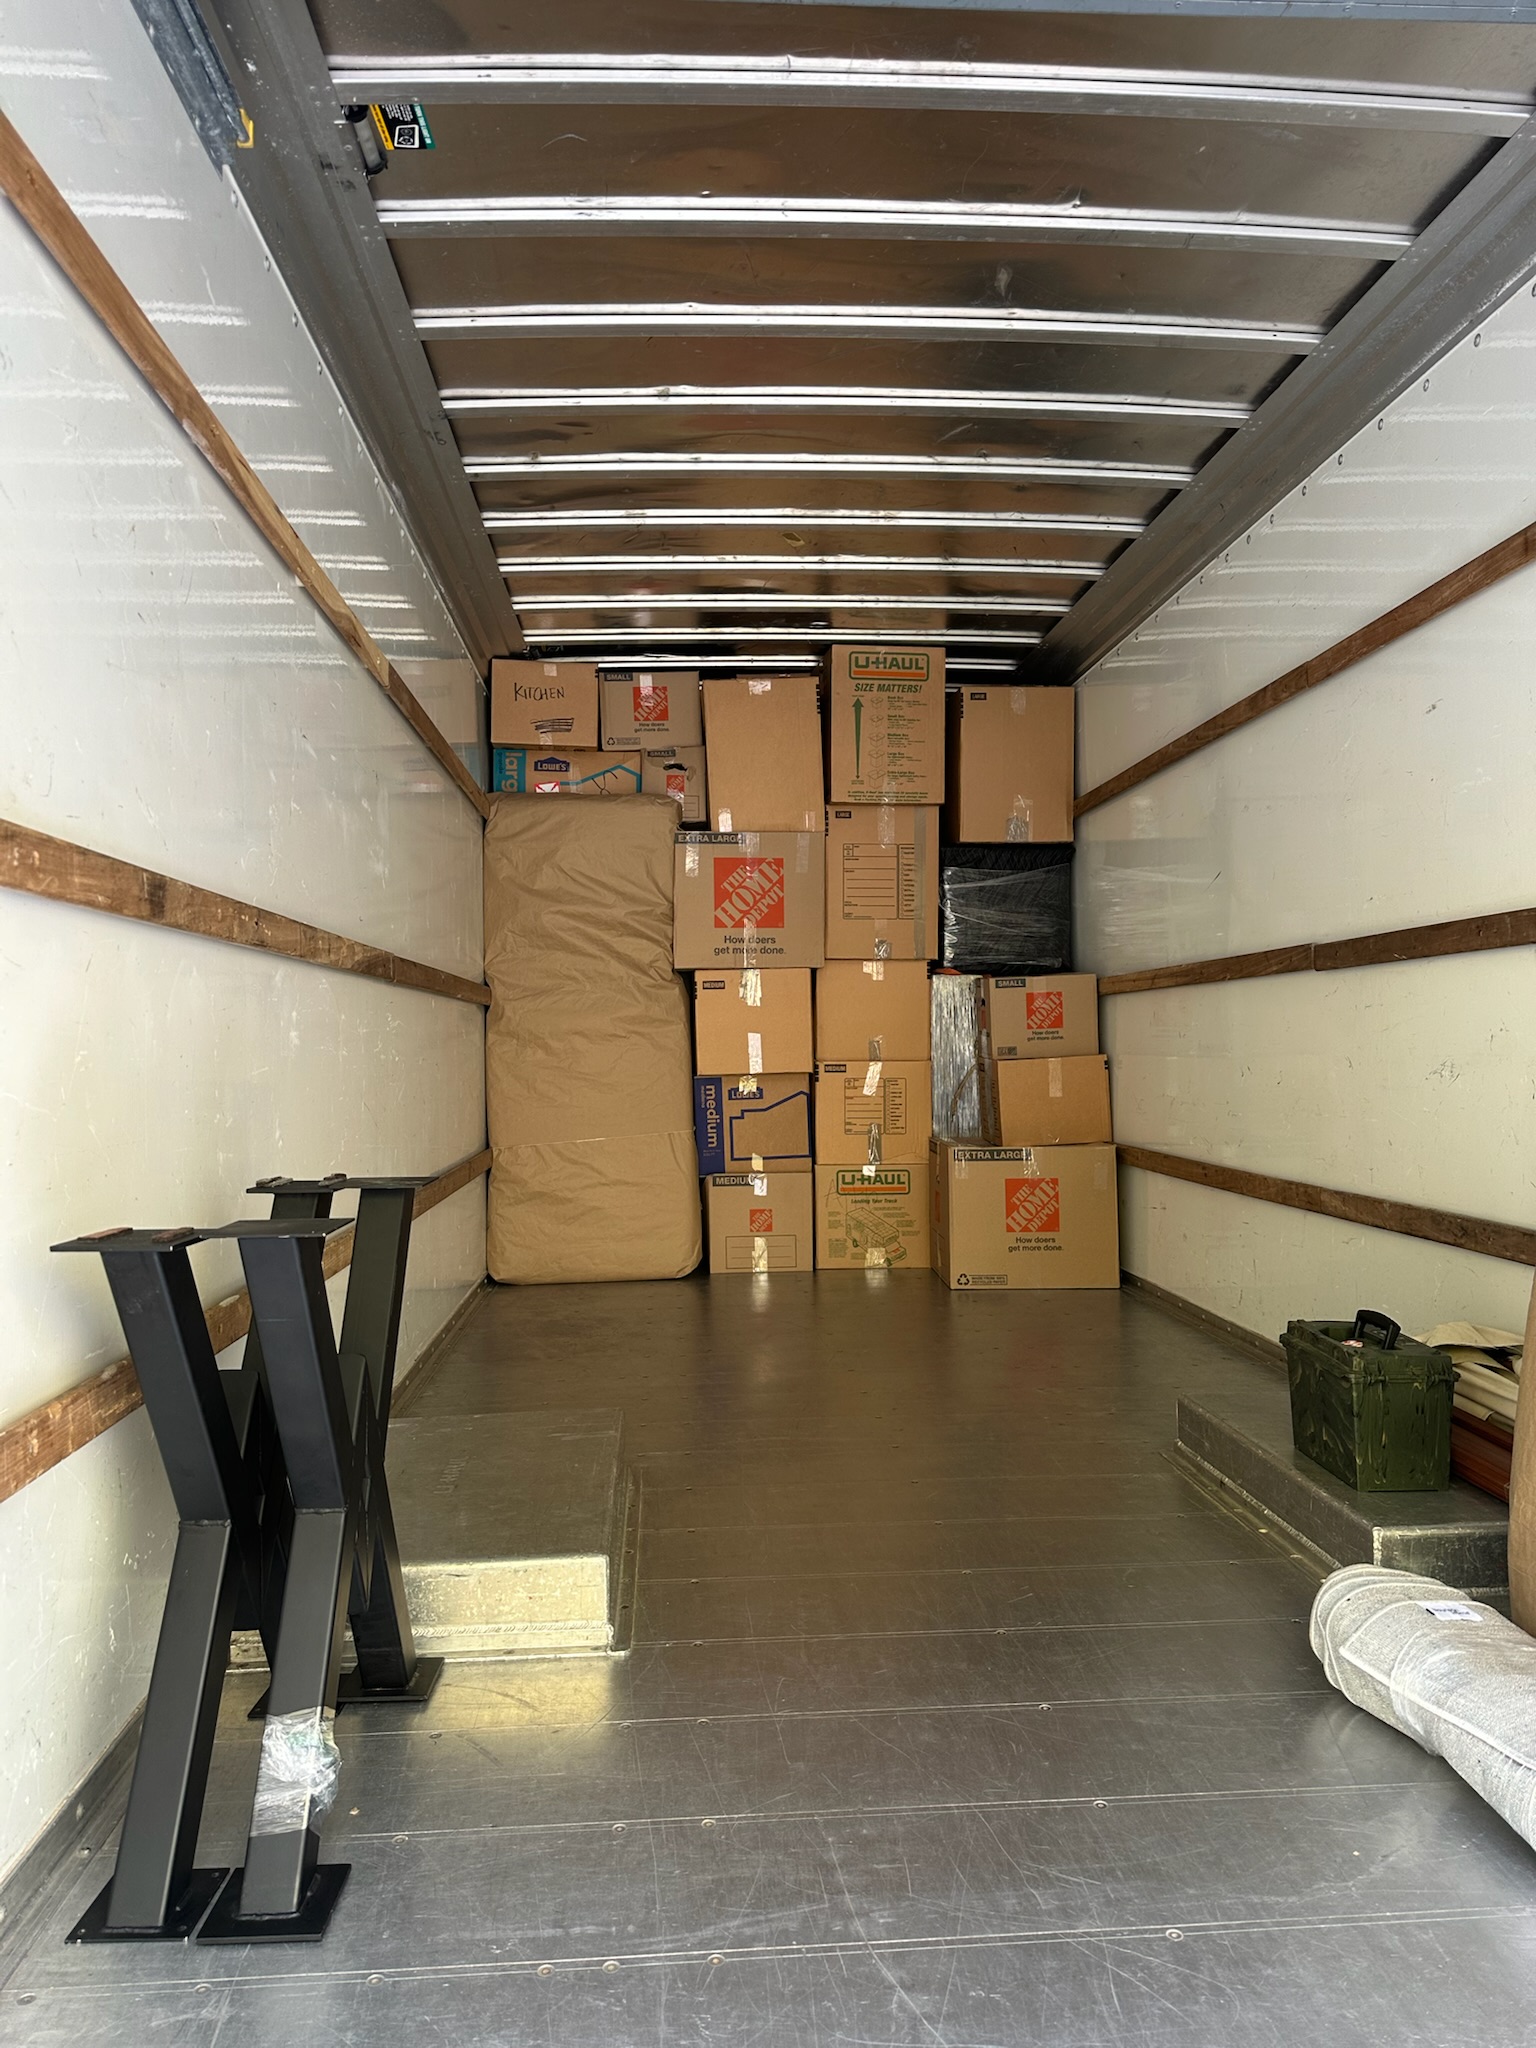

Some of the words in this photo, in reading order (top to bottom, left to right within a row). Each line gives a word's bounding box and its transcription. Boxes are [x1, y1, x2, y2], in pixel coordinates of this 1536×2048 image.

[854, 656, 925, 671] U-HAUL
[514, 682, 565, 701] KITCHEN
[854, 683, 875, 692] SIZE
[876, 684, 922, 694] MATTERS!
[501, 752, 523, 792] larg
[537, 762, 567, 771] LOWE'S
[678, 834, 709, 843] EXTRA
[711, 834, 743, 843] LARG
[720, 865, 752, 893] THE
[714, 858, 784, 929] HOME
[743, 884, 784, 929] DEPOT
[724, 935, 745, 944] How
[748, 935, 776, 944] doers
[714, 945, 730, 956] get
[997, 979, 1023, 987] SMALL
[1027, 991, 1063, 1029] HOME
[1041, 1005, 1063, 1029] DEPOT
[731, 1090, 761, 1099] LOES
[706, 1085, 720, 1148] medium
[958, 1151, 992, 1160] EXTRA
[715, 1176, 753, 1185] MEDIU
[841, 1174, 906, 1185] U-HAUL
[1010, 1184, 1033, 1206] THE
[1006, 1178, 1060, 1233] HOME
[1027, 1197, 1060, 1233] DEPOT
